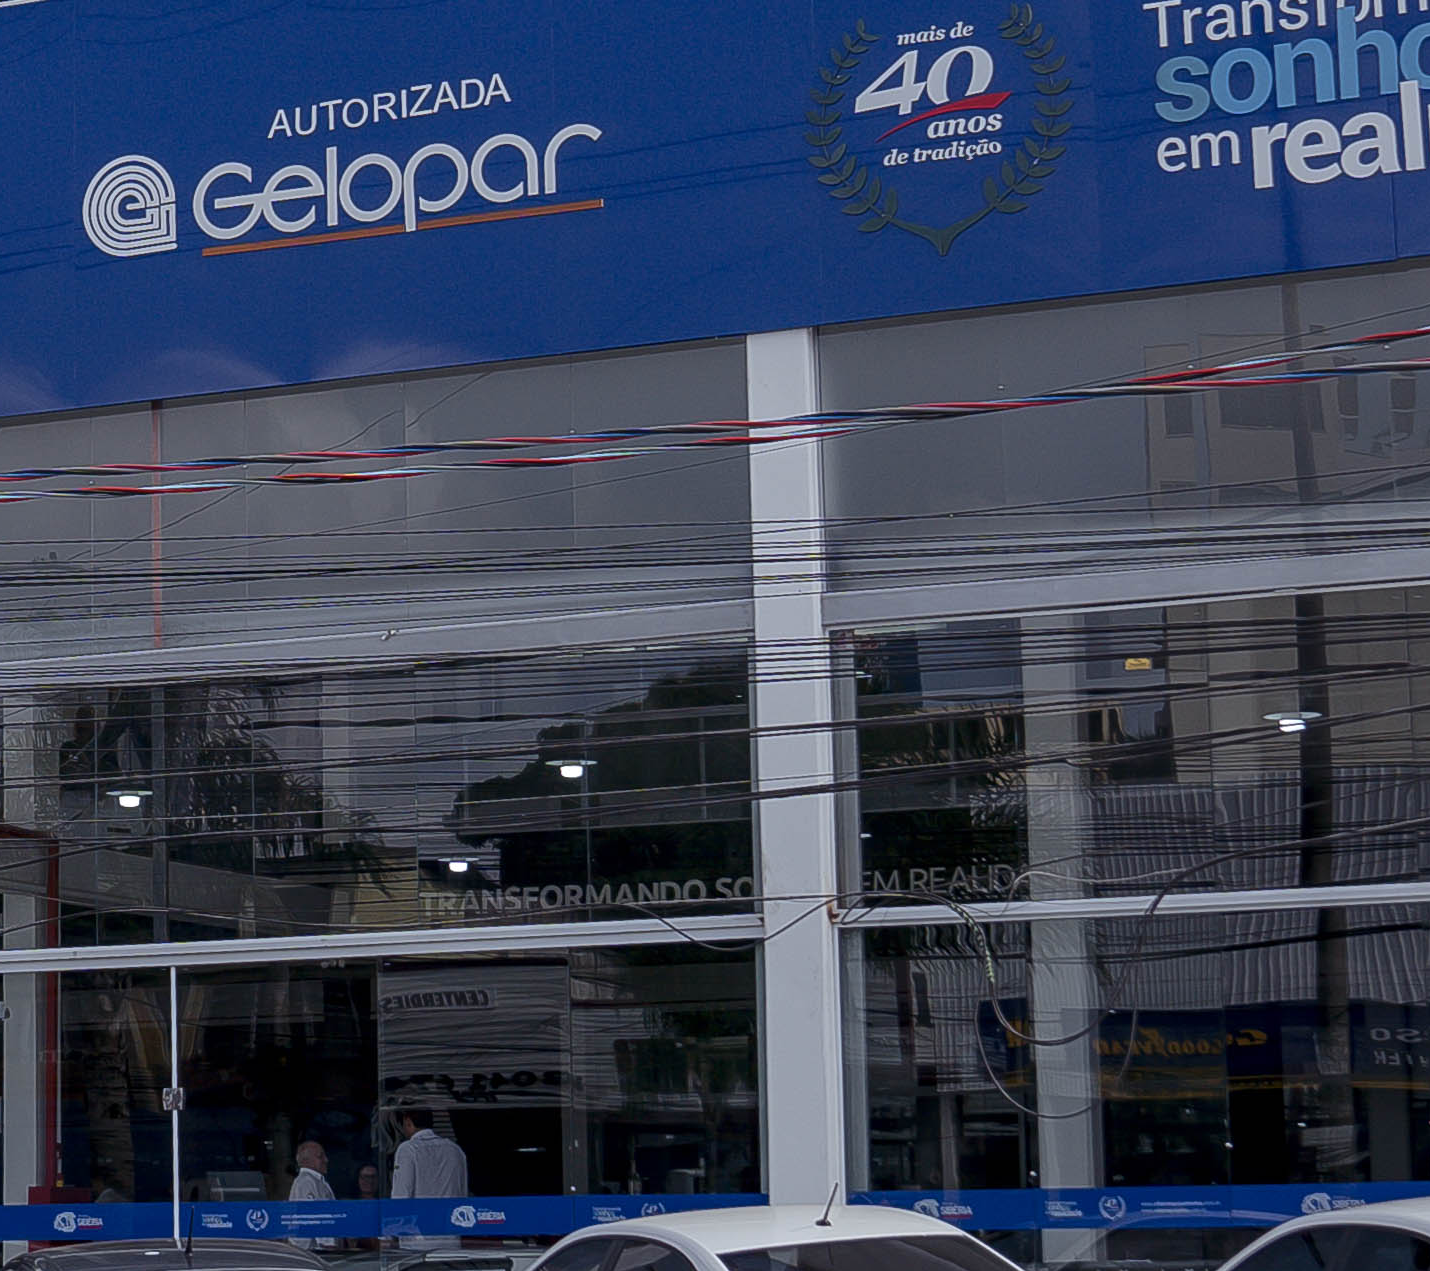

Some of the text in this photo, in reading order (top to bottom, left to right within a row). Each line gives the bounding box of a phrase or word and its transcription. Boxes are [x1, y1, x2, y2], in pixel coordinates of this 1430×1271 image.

[896, 21, 975, 46] mais de
[853, 44, 995, 117] 40
[267, 73, 512, 139] AUTORIZADA
[926, 110, 1003, 140] anos
[883, 139, 1003, 168] de tradição
[1156, 125, 1240, 172] em
[419, 878, 707, 916] TRANSFORMANDO
